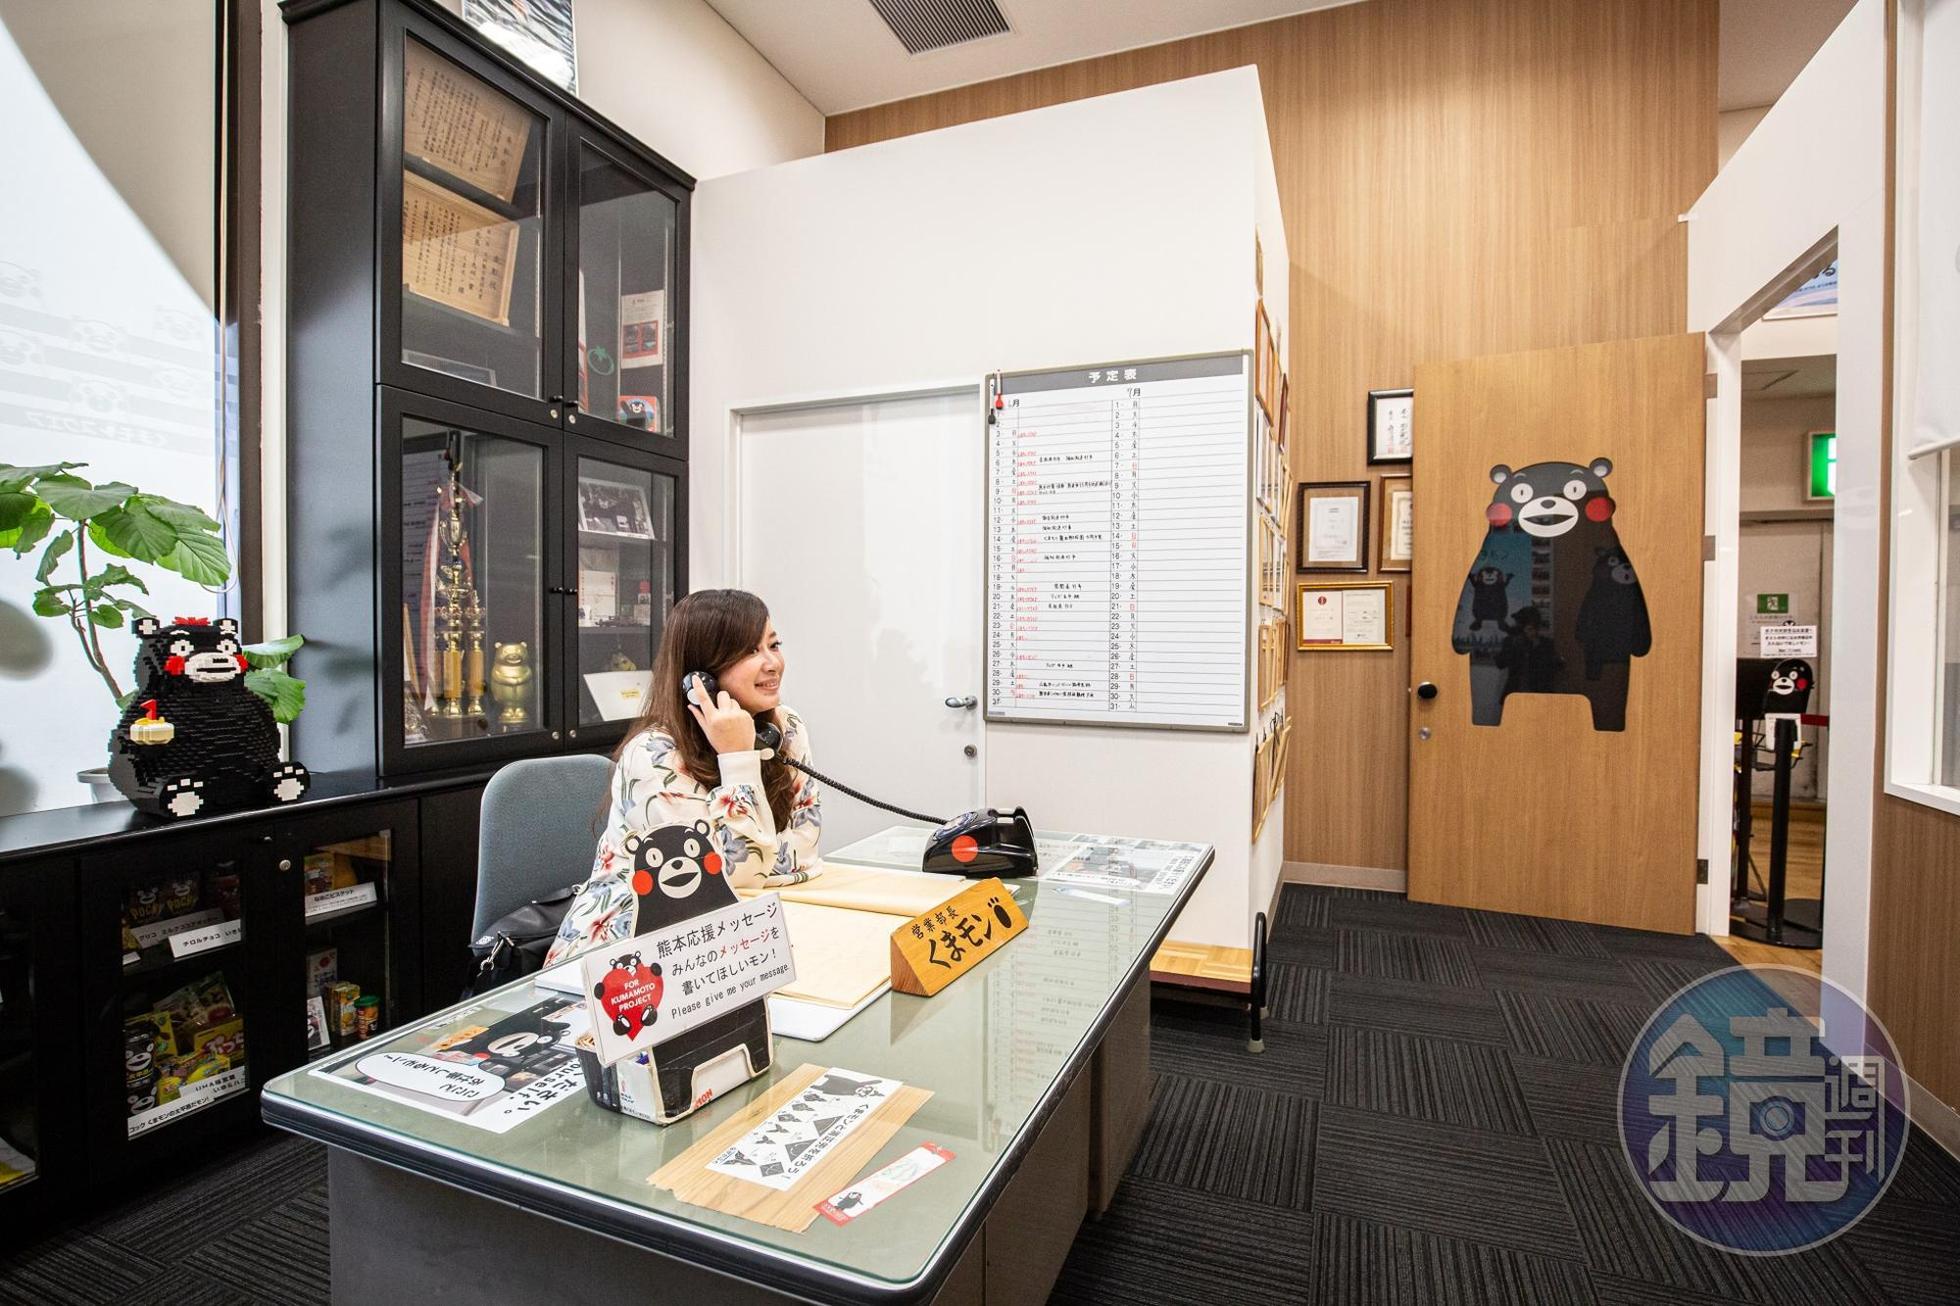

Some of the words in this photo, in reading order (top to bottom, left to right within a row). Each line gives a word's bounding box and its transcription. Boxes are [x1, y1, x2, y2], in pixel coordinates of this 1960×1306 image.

[1088, 368, 1137, 383] 予定表
[182, 932, 222, 948] チロルチョコ
[656, 901, 778, 960] 熊本応援メッセージ
[911, 905, 960, 940] 営業部長
[671, 926, 780, 977] みんなのメッセージを
[929, 913, 993, 970] くまモン
[624, 979, 640, 991] FOR
[681, 947, 777, 996] 書いてほしいモン!
[610, 982, 656, 1006] KUMAMOTO
[618, 995, 652, 1013] PROJECT
[671, 1000, 702, 1020] Please
[704, 991, 724, 1008] give
[726, 987, 738, 997] me
[740, 977, 758, 991] your
[760, 963, 790, 985] message
[510, 1063, 581, 1099] ourself.
